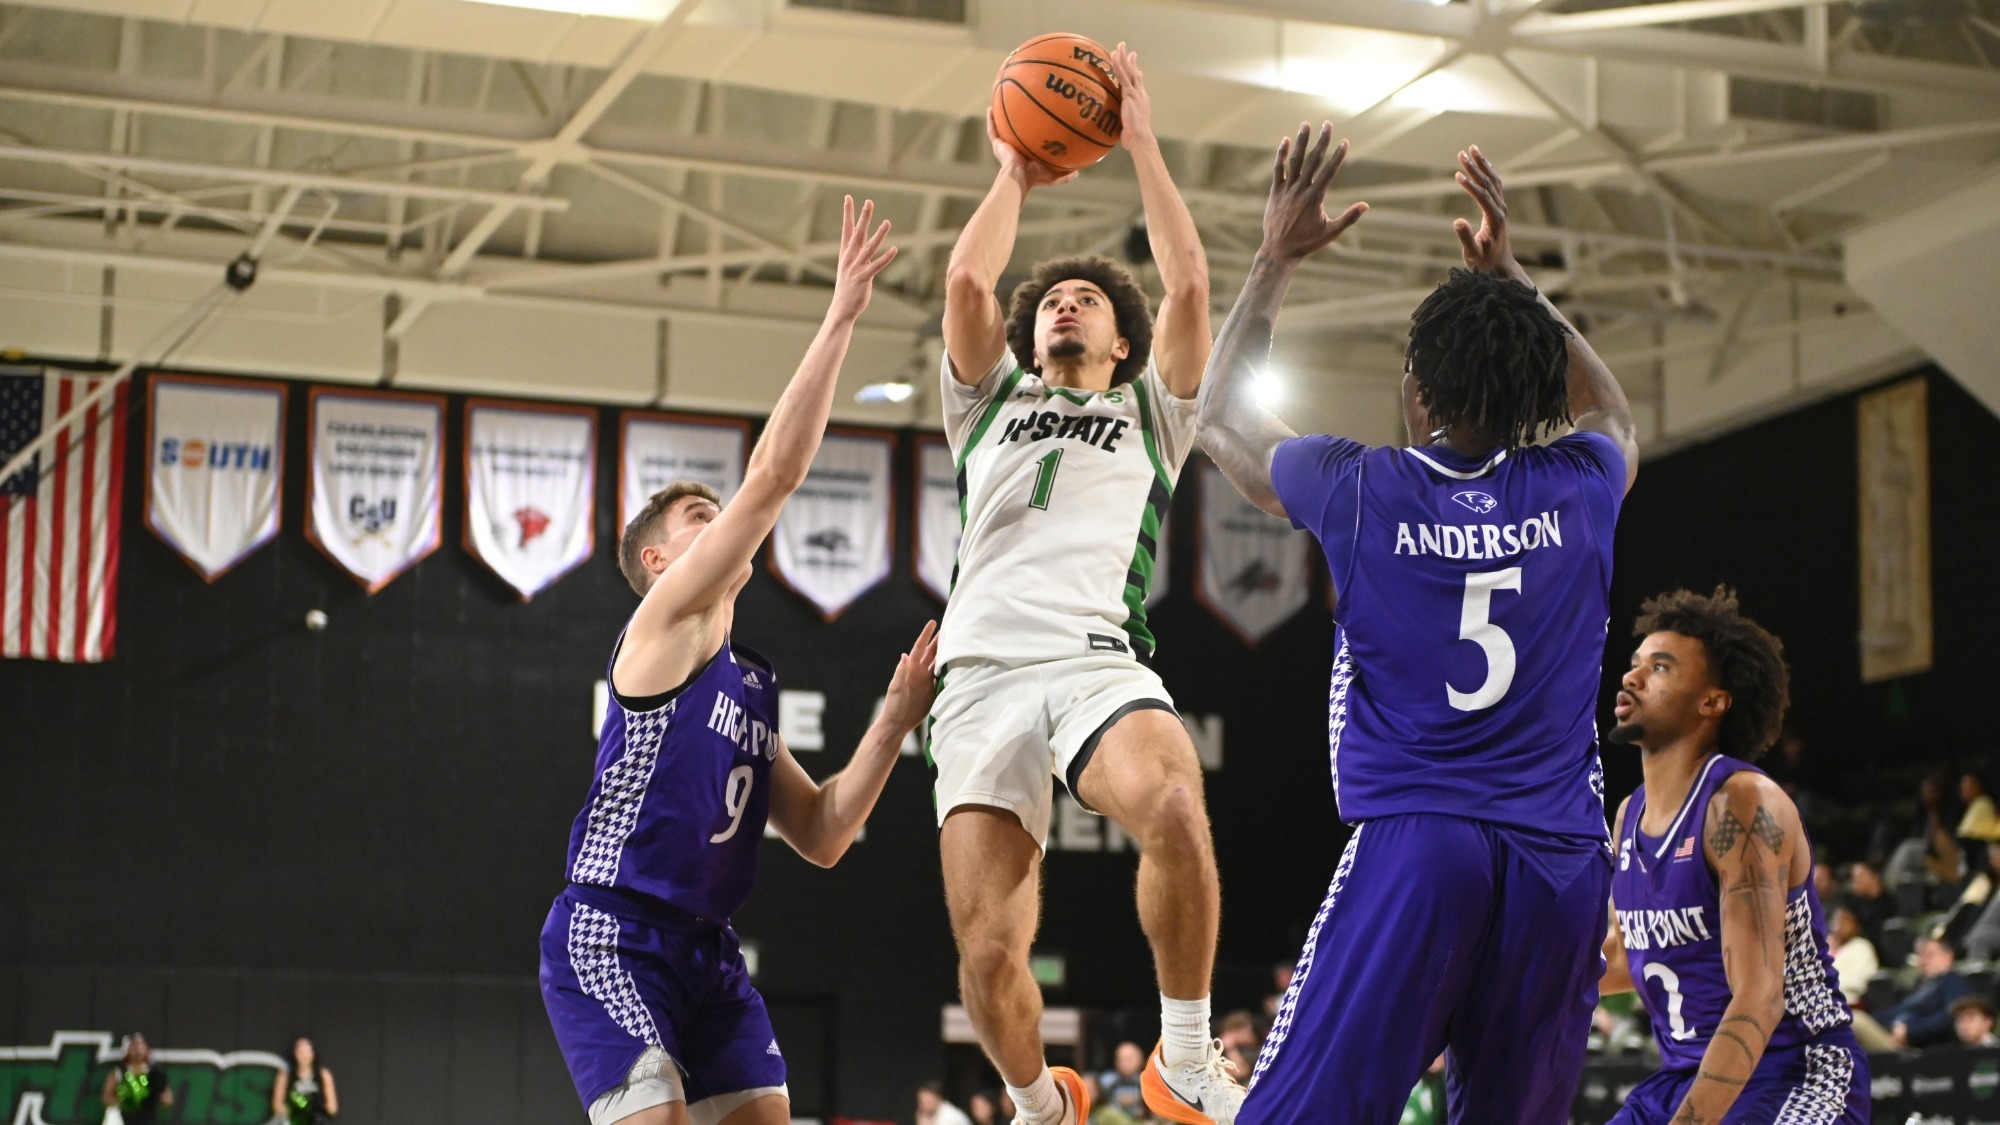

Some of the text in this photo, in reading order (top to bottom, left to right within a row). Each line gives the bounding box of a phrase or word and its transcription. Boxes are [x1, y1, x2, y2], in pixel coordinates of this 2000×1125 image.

[1074, 46, 1117, 85] CAA
[1046, 73, 1120, 137] Wilson
[1028, 447, 1064, 511] 1
[1394, 510, 1562, 560] ANDERSON
[1445, 566, 1523, 712] 5
[709, 765, 754, 844] 9
[1643, 962, 1698, 1041] 2
